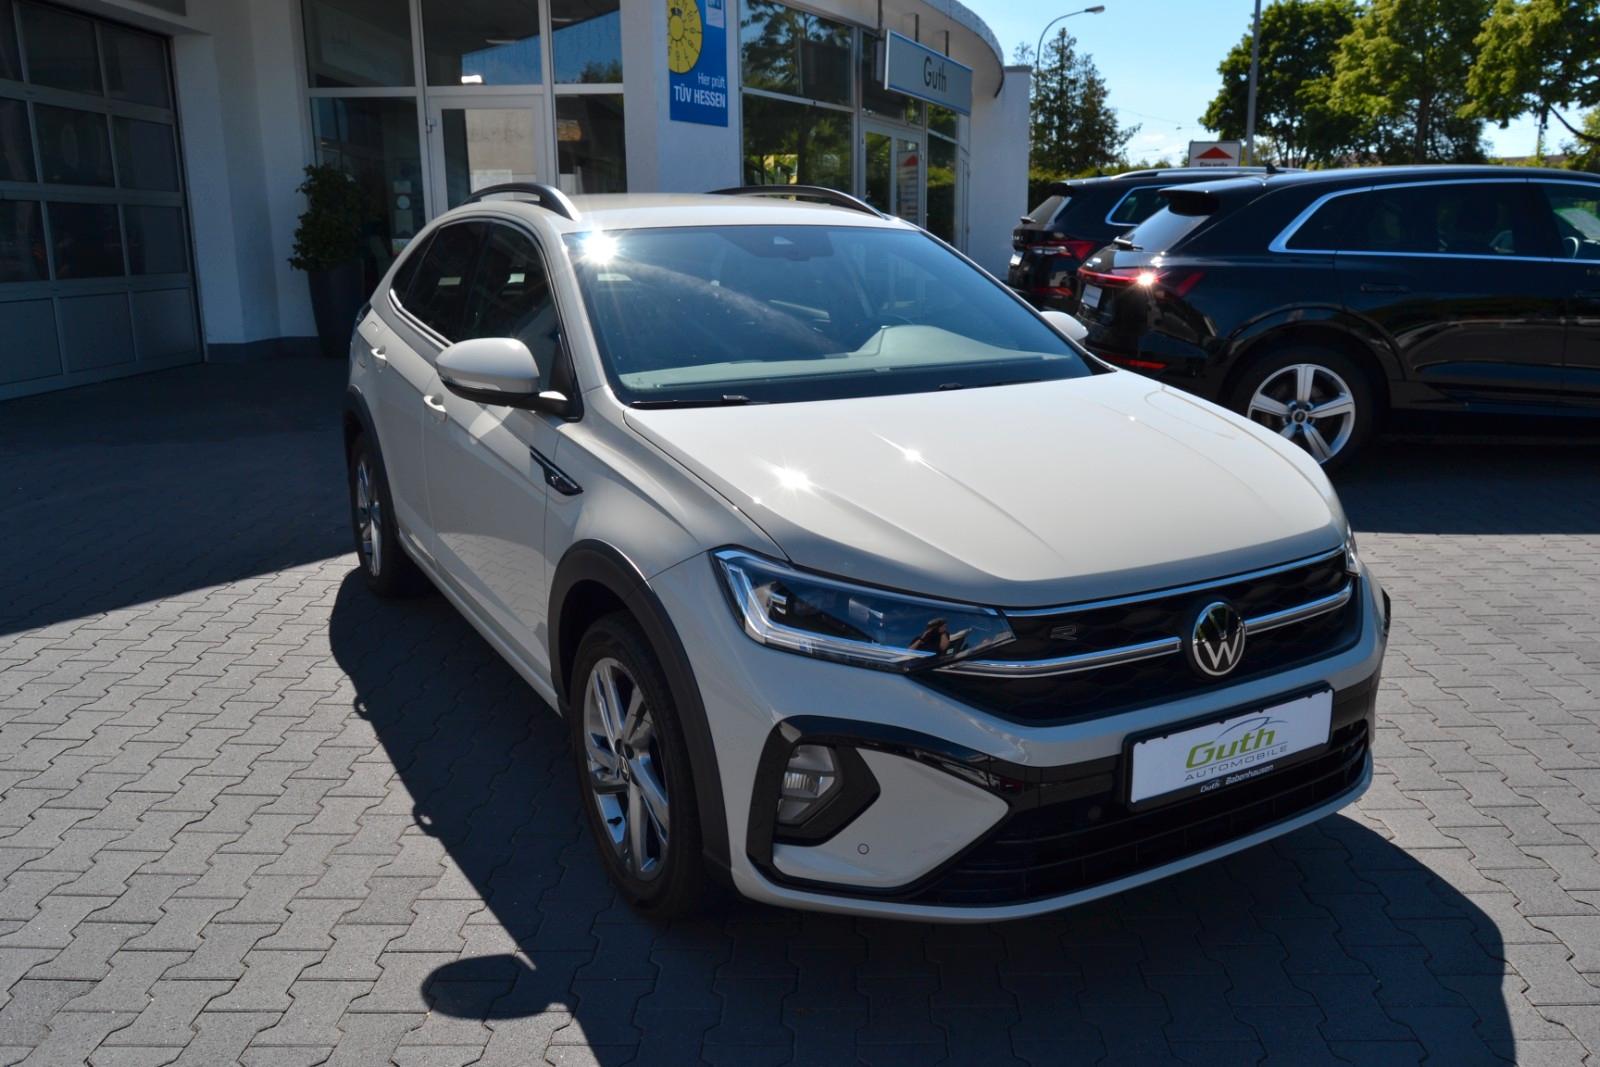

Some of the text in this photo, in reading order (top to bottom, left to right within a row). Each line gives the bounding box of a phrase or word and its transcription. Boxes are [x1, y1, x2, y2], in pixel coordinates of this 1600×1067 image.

[924, 56, 947, 92] Guth
[674, 83, 726, 108] TÜV HESSEN
[1185, 745, 1287, 781] AUTOMOBILE
[1186, 728, 1275, 769] Guth
